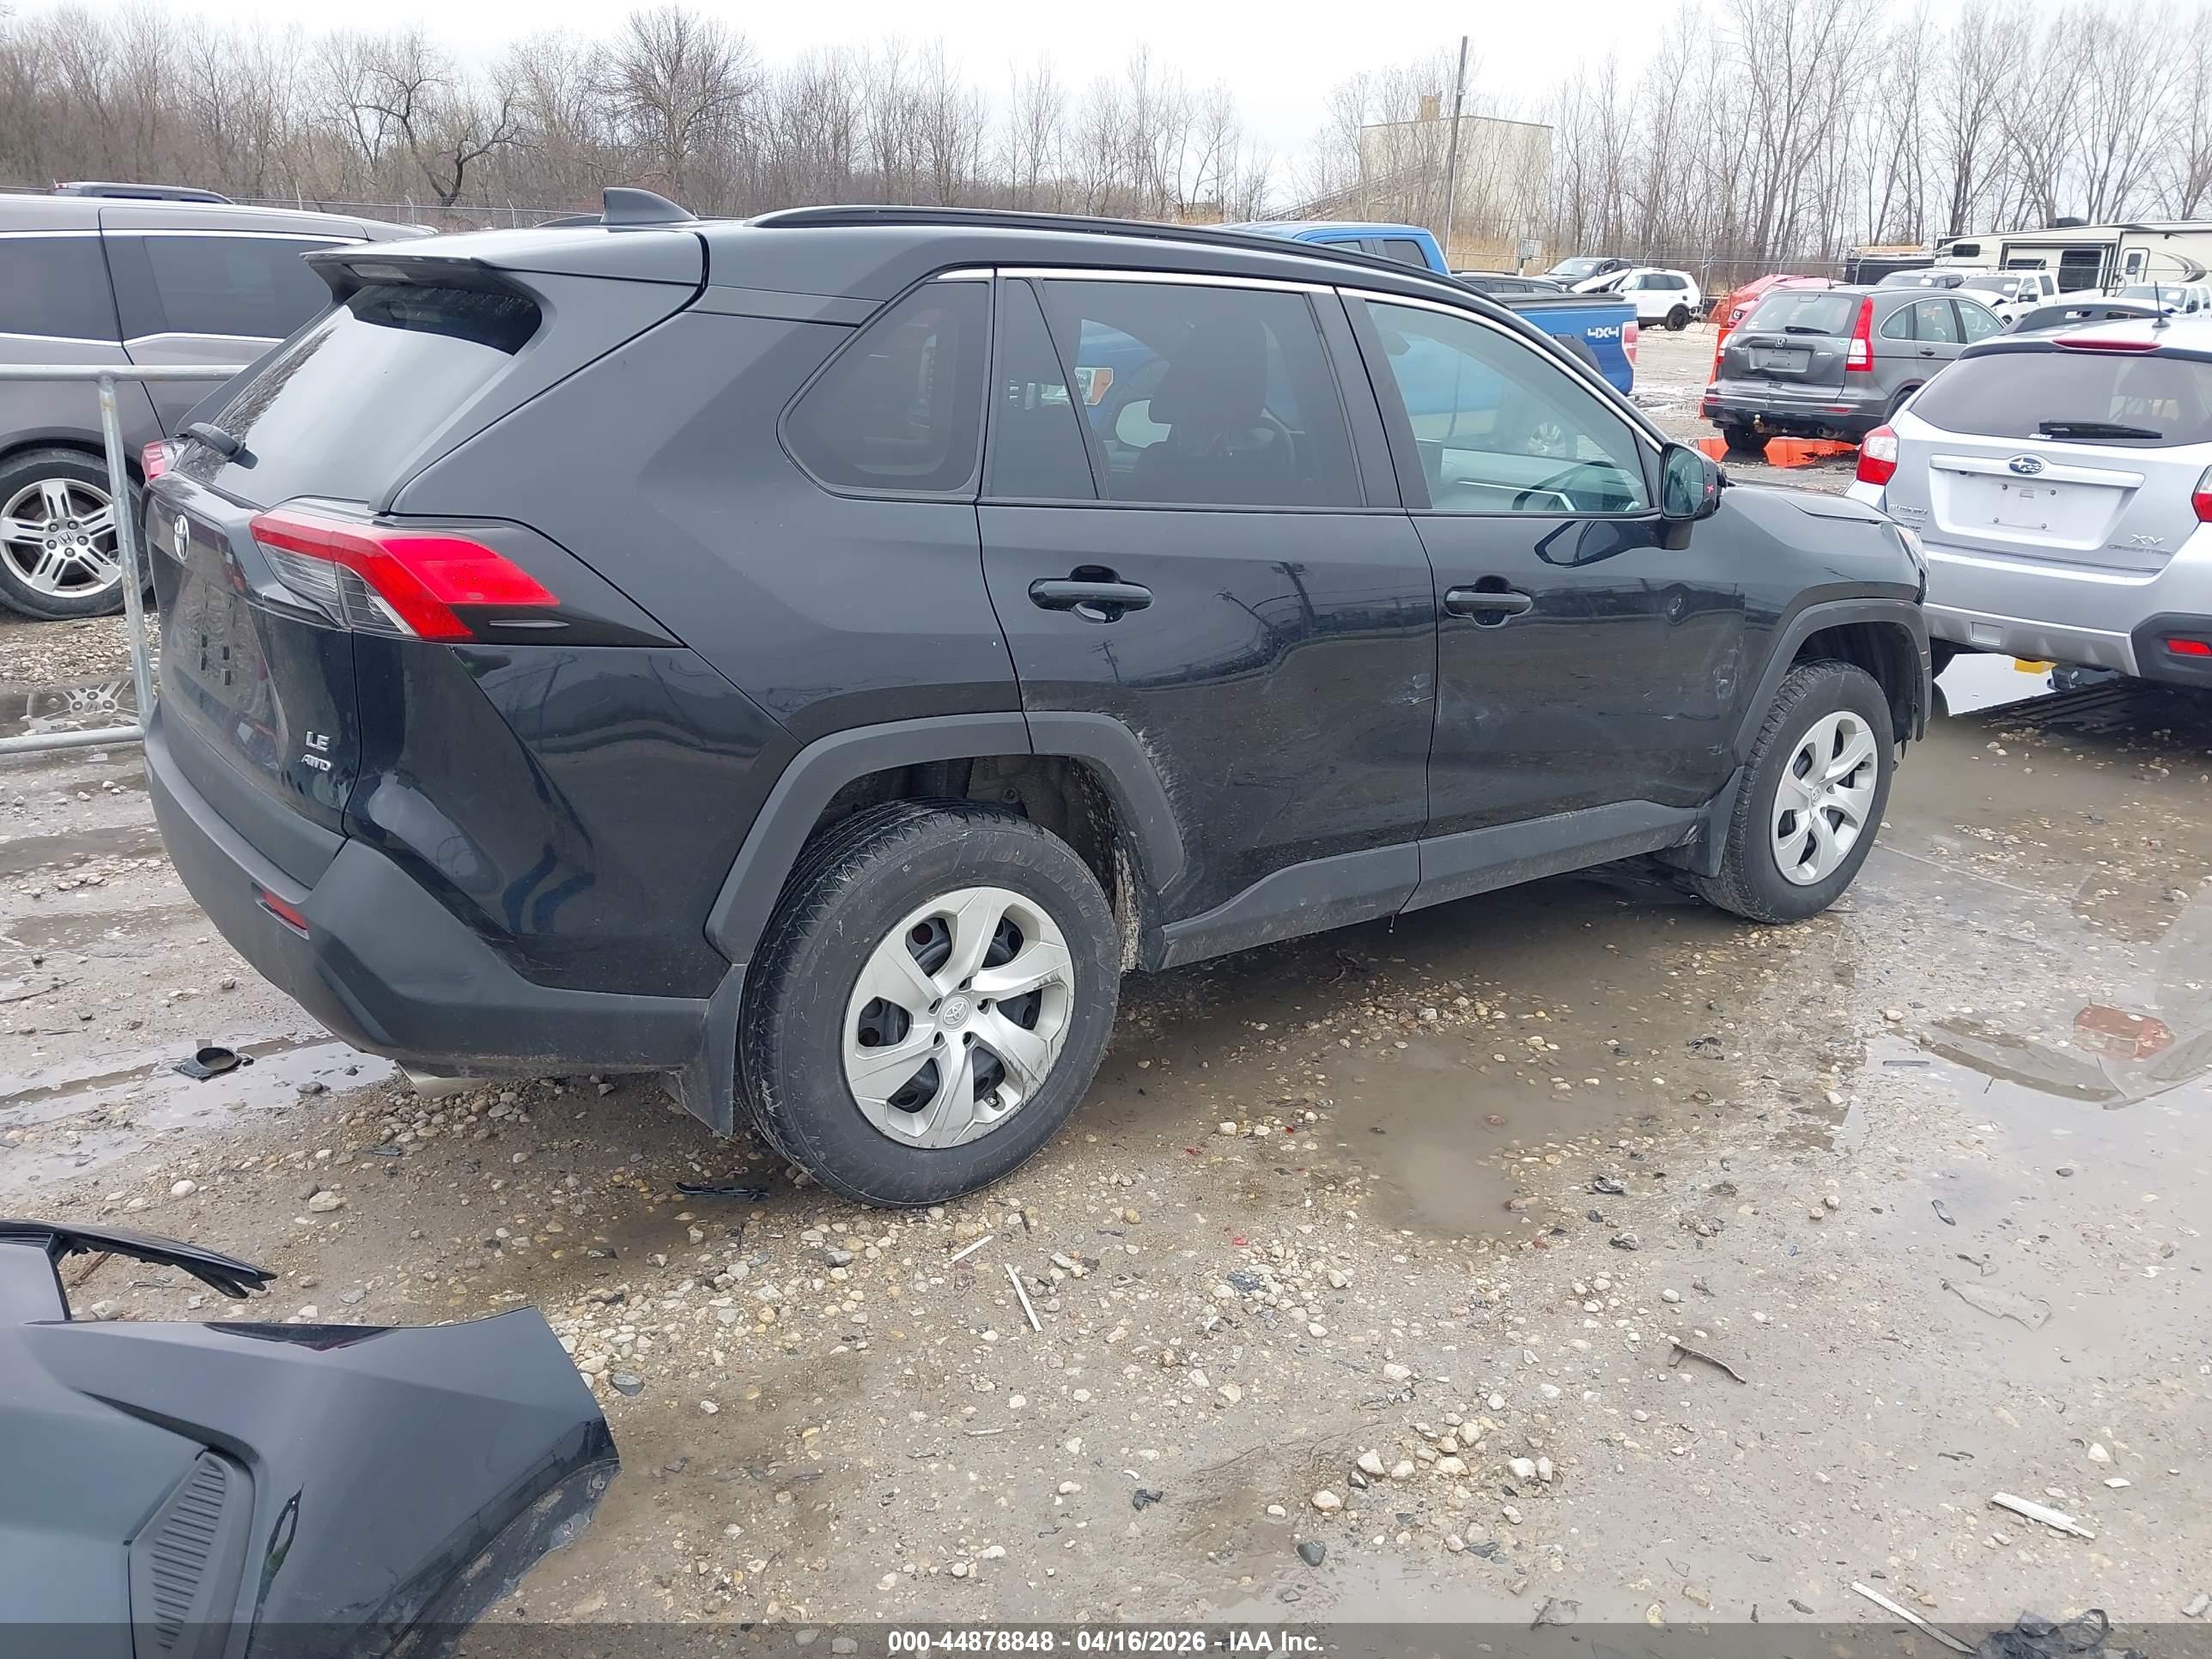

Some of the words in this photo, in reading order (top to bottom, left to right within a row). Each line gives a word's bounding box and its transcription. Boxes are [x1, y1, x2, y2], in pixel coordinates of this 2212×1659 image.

[2129, 533, 2165, 544] XV
[306, 731, 331, 752] LE
[301, 754, 332, 771] AWD
